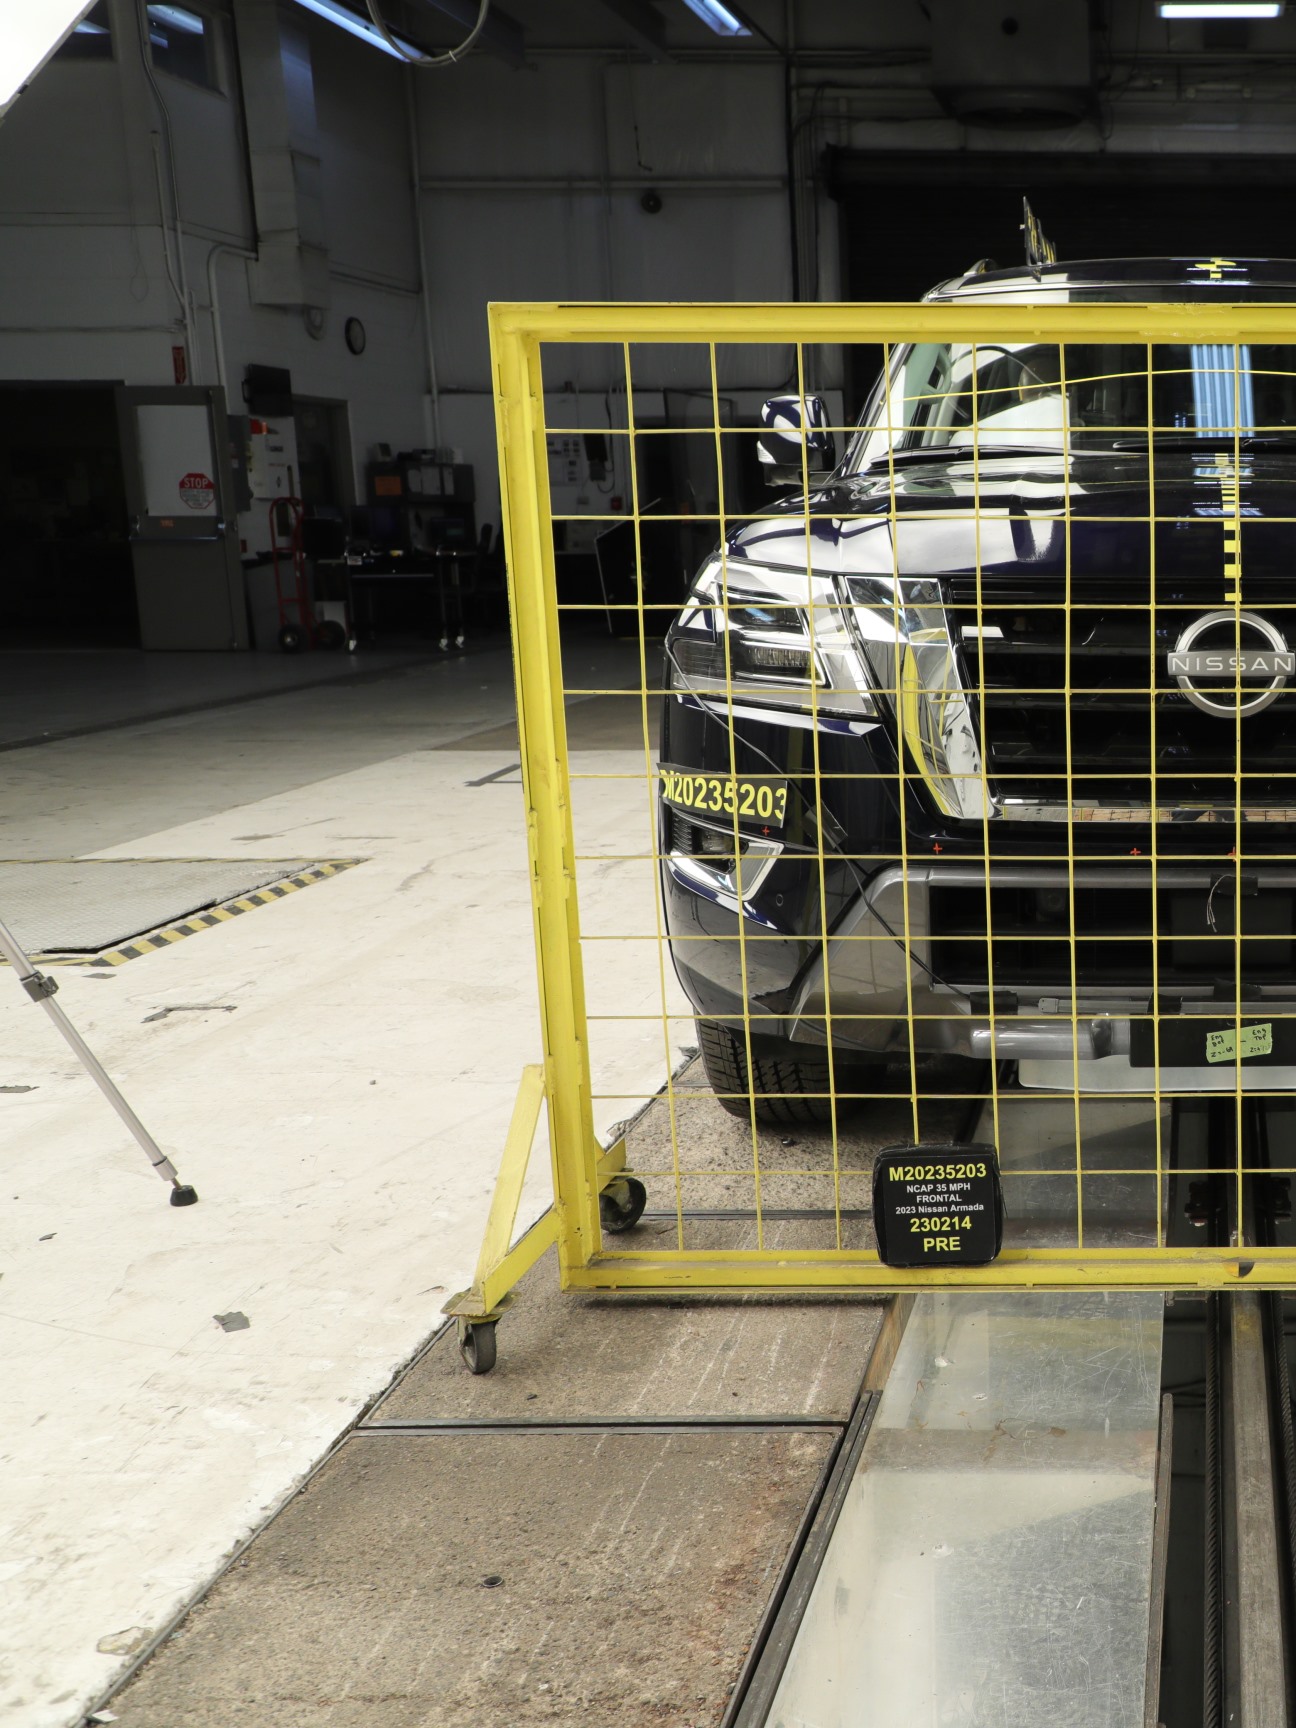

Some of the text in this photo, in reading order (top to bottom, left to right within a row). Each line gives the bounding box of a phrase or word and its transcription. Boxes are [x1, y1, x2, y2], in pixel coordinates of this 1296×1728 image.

[183, 477, 209, 488] STOP
[1172, 657, 1292, 672] NISSAN
[888, 1163, 987, 1181] M20235203
[906, 1182, 971, 1193] NCAP 35 MPH
[916, 1193, 962, 1203] FRONTAL
[895, 1203, 984, 1214] 2023 Nissan Armada
[909, 1215, 972, 1232] 230214
[923, 1236, 961, 1252] PRE
